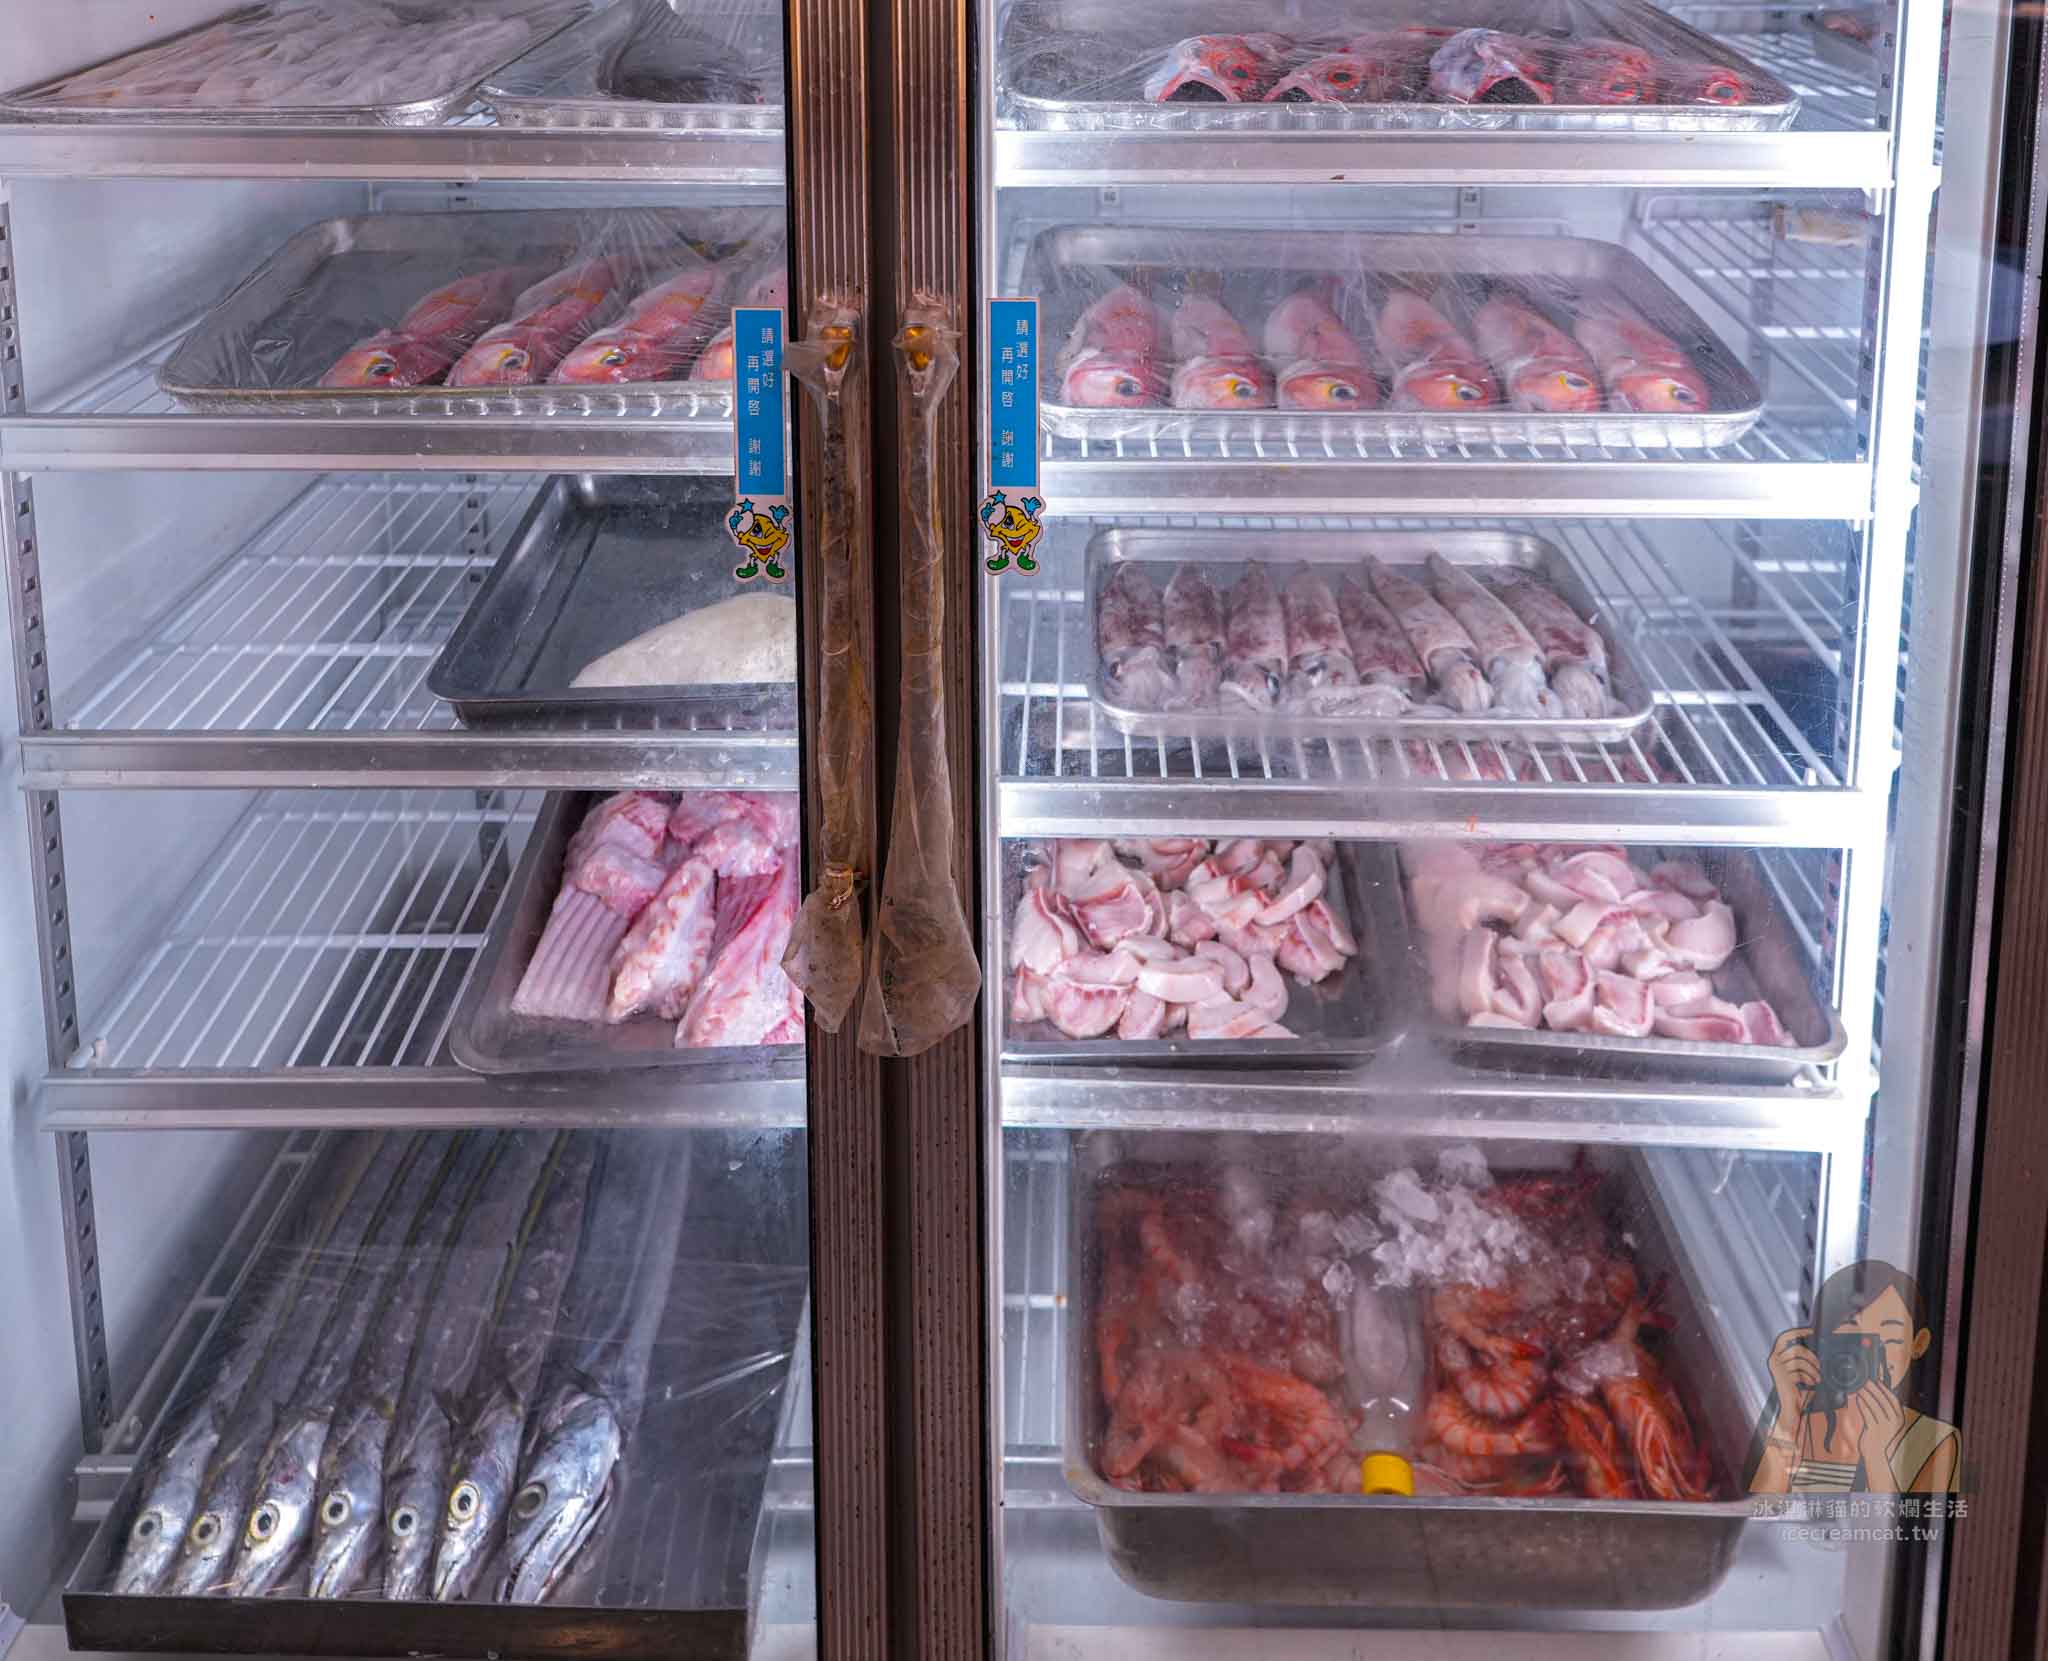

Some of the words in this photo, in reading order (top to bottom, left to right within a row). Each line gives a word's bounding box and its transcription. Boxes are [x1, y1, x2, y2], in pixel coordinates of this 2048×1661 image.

[760, 327, 774, 388] 請選好
[1015, 319, 1029, 379] 請選好
[747, 437, 761, 477] 謝謝
[1001, 429, 1014, 468] 謝謝
